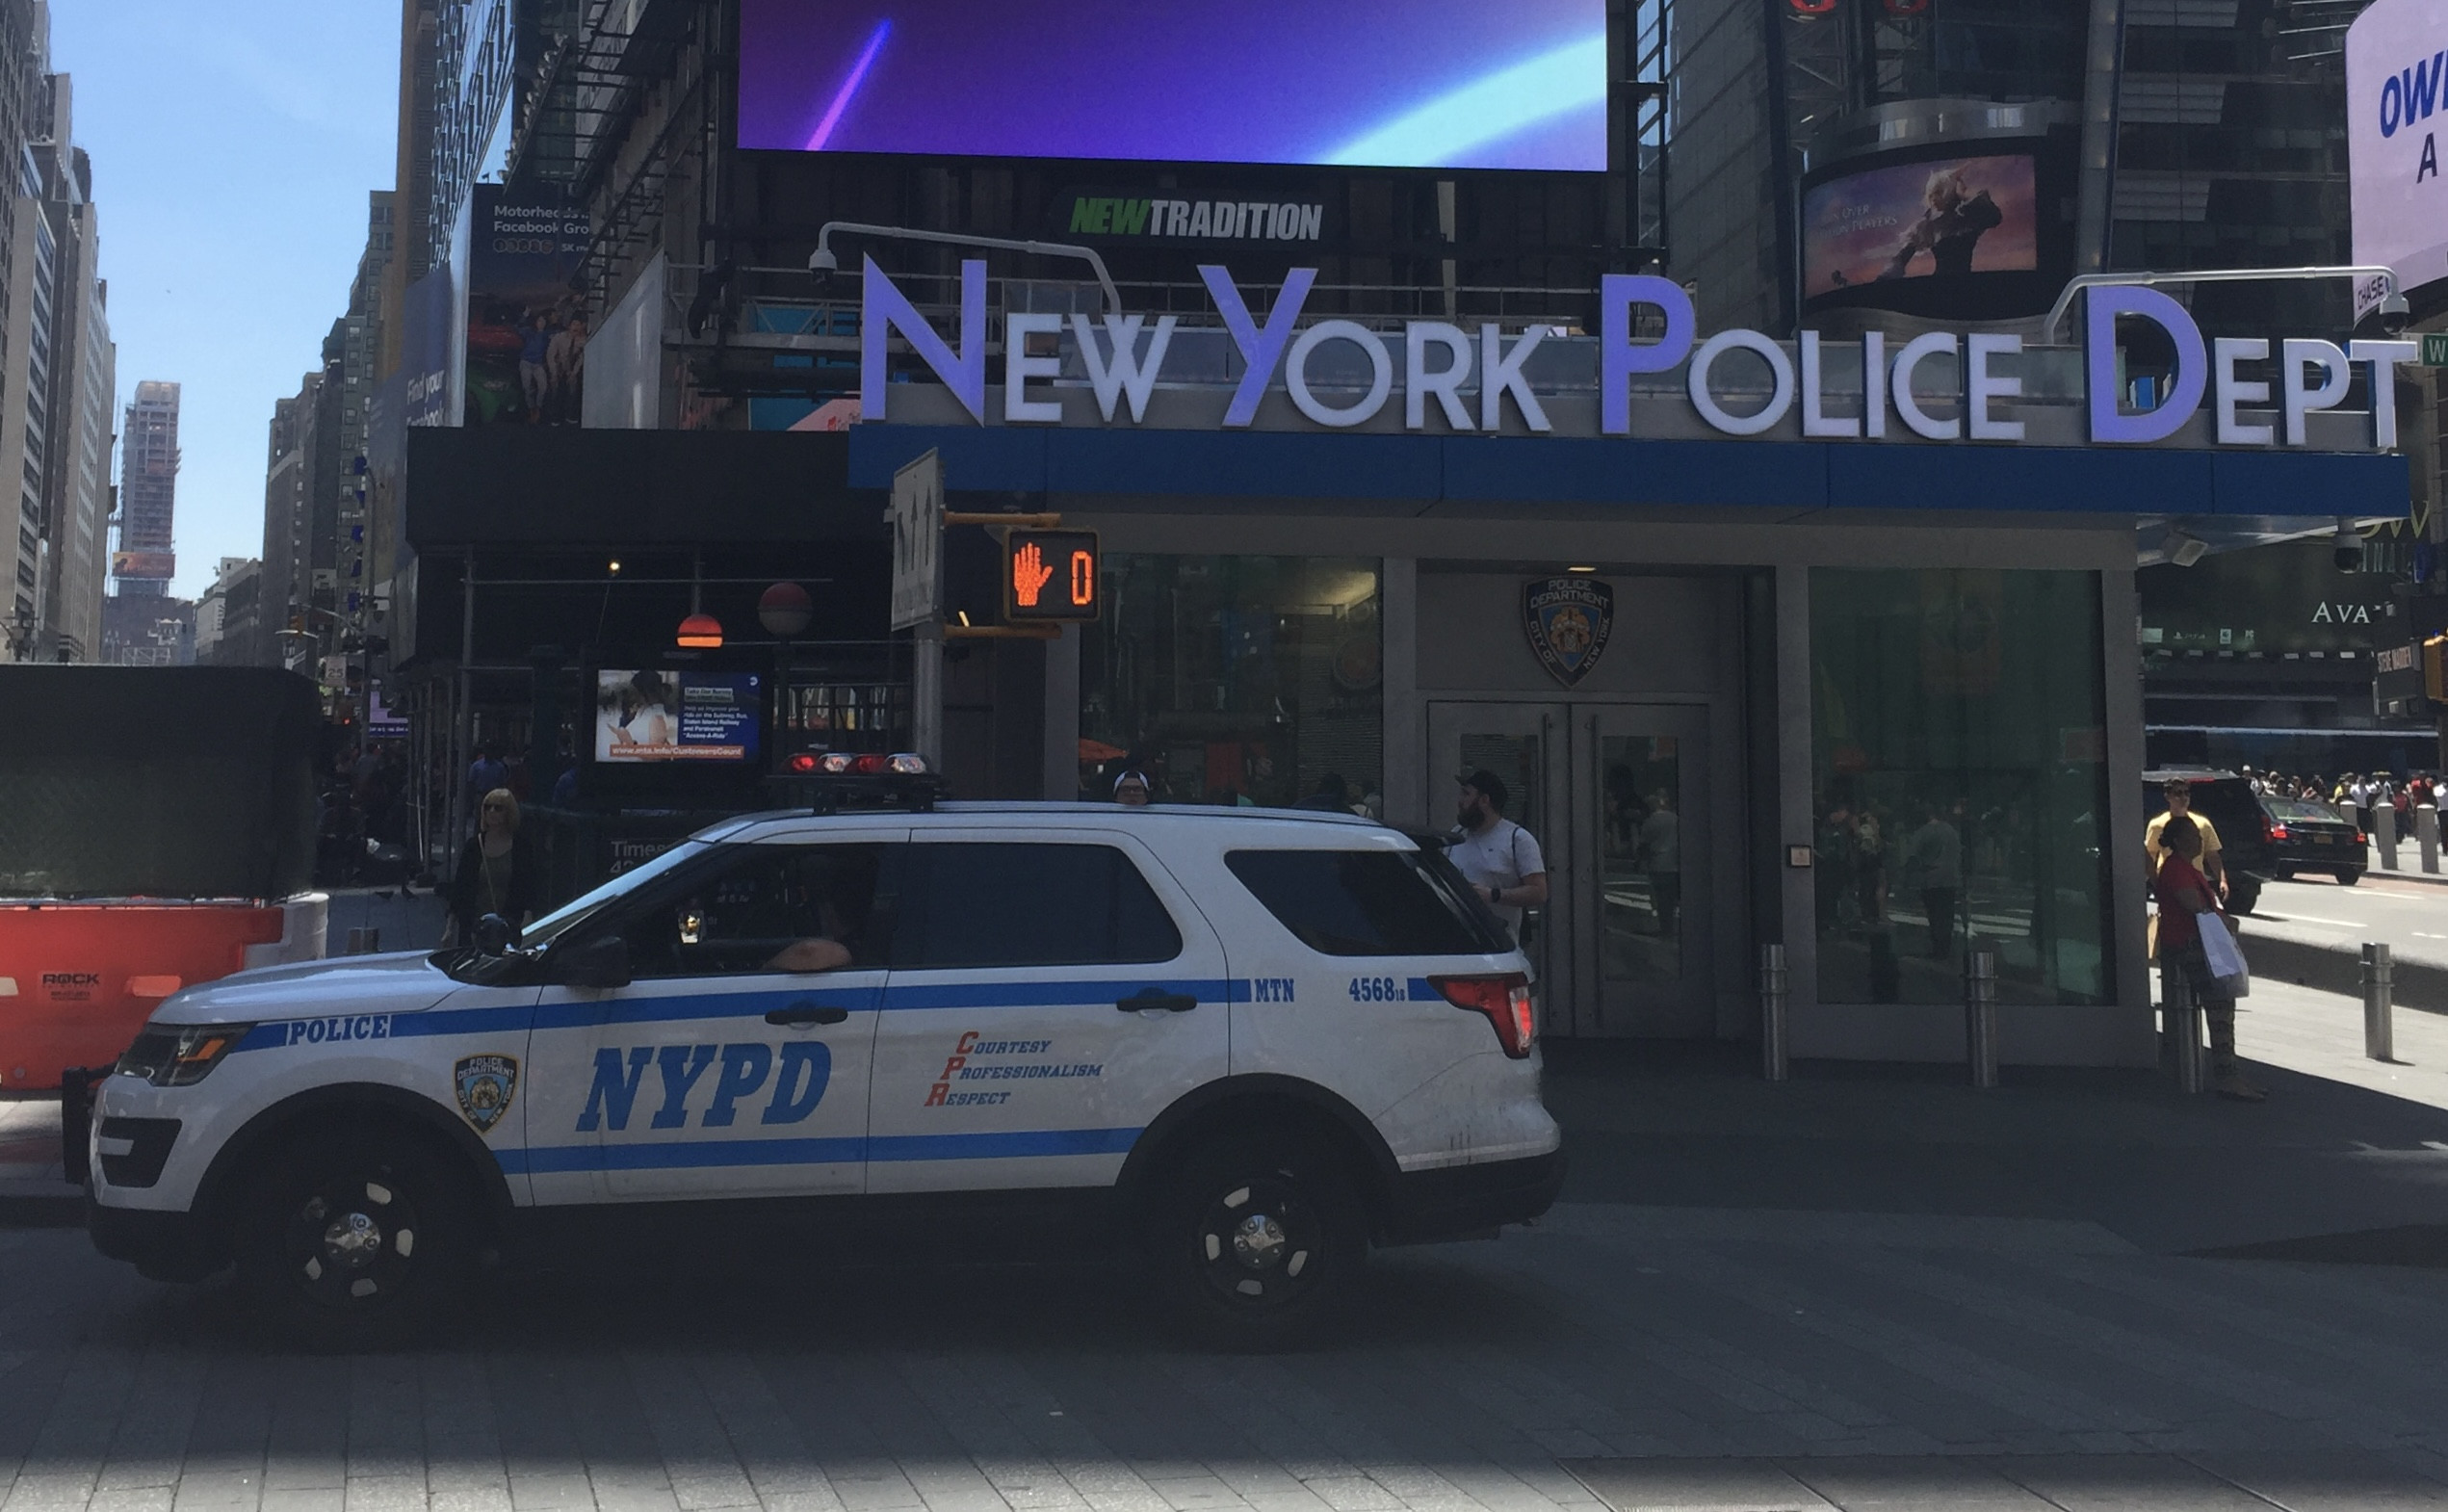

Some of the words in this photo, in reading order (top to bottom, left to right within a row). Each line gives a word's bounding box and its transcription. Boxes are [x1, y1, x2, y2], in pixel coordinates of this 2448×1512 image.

[2381, 49, 2448, 139] OW
[2416, 132, 2437, 184] A
[494, 222, 559, 233] Facebook
[2357, 275, 2384, 310] CHASE
[861, 250, 1179, 429] NEW
[1196, 264, 1553, 431] YORK
[1601, 274, 2026, 441] POLICE
[2085, 285, 2418, 449] DEPT
[2428, 339, 2447, 363] W
[1548, 579, 1591, 590] POLICE
[1530, 589, 1609, 609] DEPARTMENT
[1529, 620, 1547, 646] CITY
[1543, 649, 1557, 664] OF
[1583, 645, 1600, 669] NEW
[1597, 617, 1610, 643] YORK
[42, 973, 100, 984] ROCK
[1255, 978, 1294, 1003] MTN
[289, 1015, 388, 1046] POLICE
[956, 1030, 1052, 1056] COURTESY
[457, 1064, 515, 1081] DEPARTMENT
[470, 1056, 504, 1067] POLICE
[940, 1056, 1104, 1081] PROFESSIONALISM
[575, 1041, 832, 1132] NYPD
[924, 1082, 1011, 1108] RESPECT
